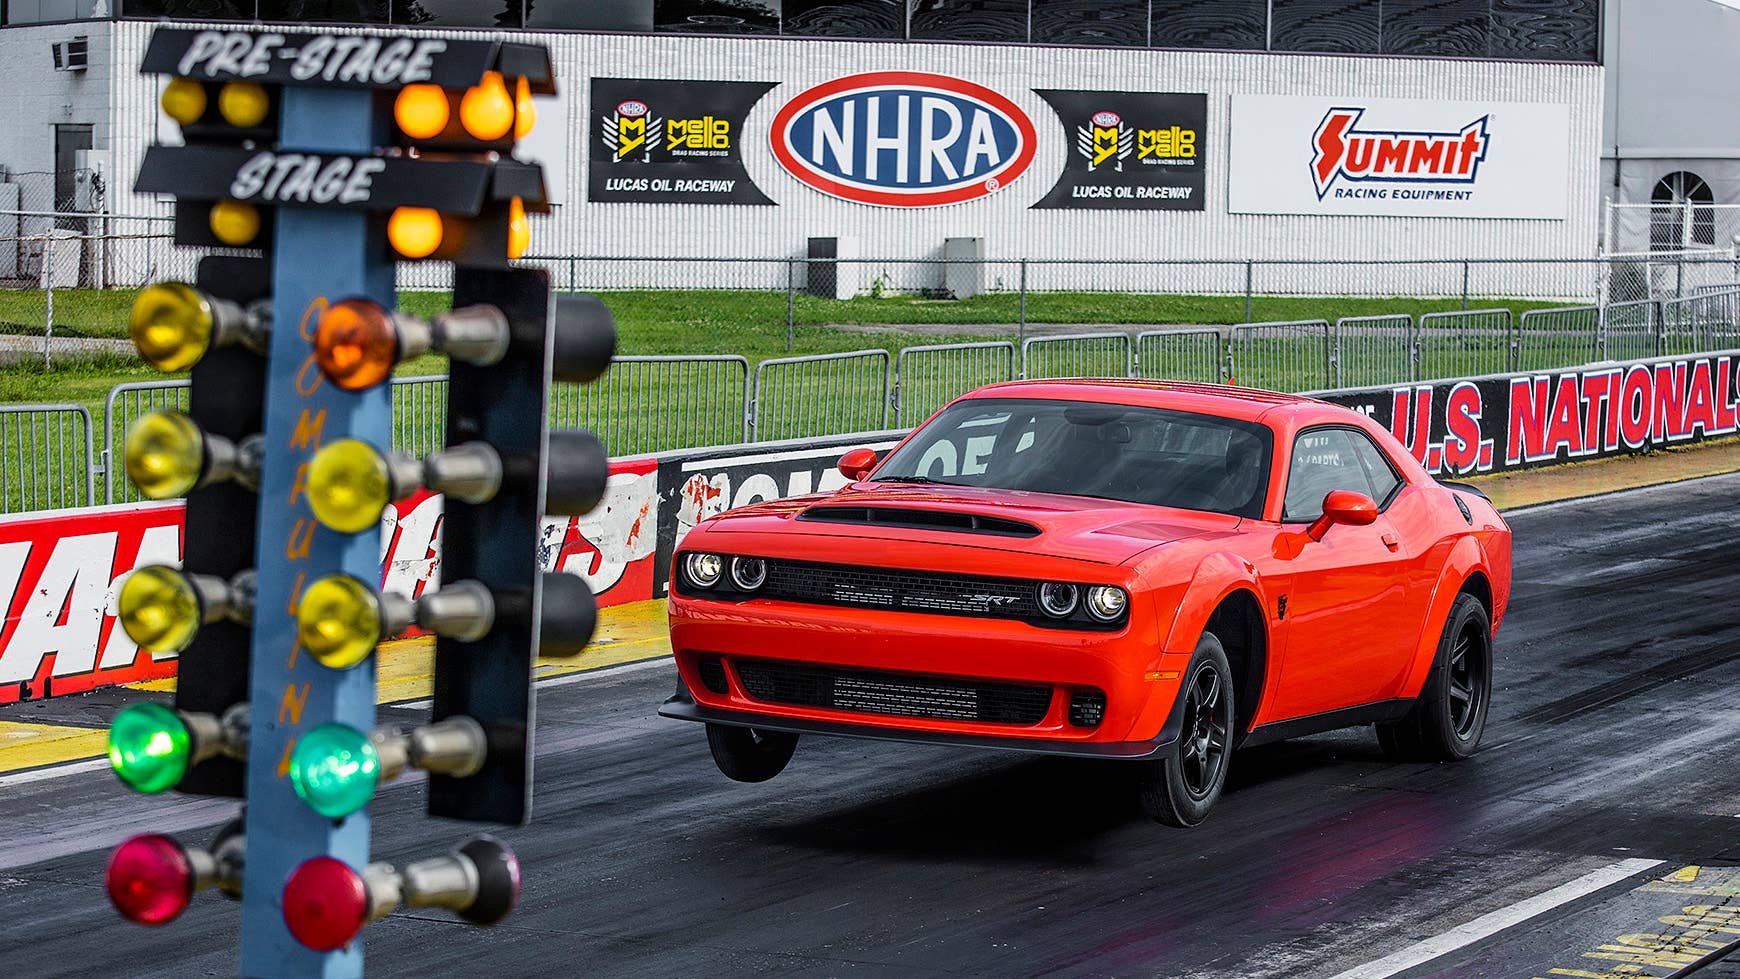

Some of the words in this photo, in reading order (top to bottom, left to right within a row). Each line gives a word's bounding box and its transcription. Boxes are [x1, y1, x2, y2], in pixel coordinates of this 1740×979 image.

[177, 31, 447, 83] PRE-STAGE
[812, 95, 1000, 183] NHRA
[230, 152, 386, 203] STAGE
[605, 178, 649, 192] LUCAS
[650, 179, 673, 192] OIL
[674, 179, 736, 192] RACEWAY
[1072, 185, 1112, 198] LUCAS
[1113, 186, 1134, 198] OIL
[1135, 187, 1193, 199] RACEWAY
[1334, 188, 1388, 199] RACING
[1391, 189, 1474, 201] EQUIPMENT
[1386, 381, 1495, 475] U.S.
[1505, 356, 1740, 466] NATIONAL
[973, 594, 1021, 606] SRT
